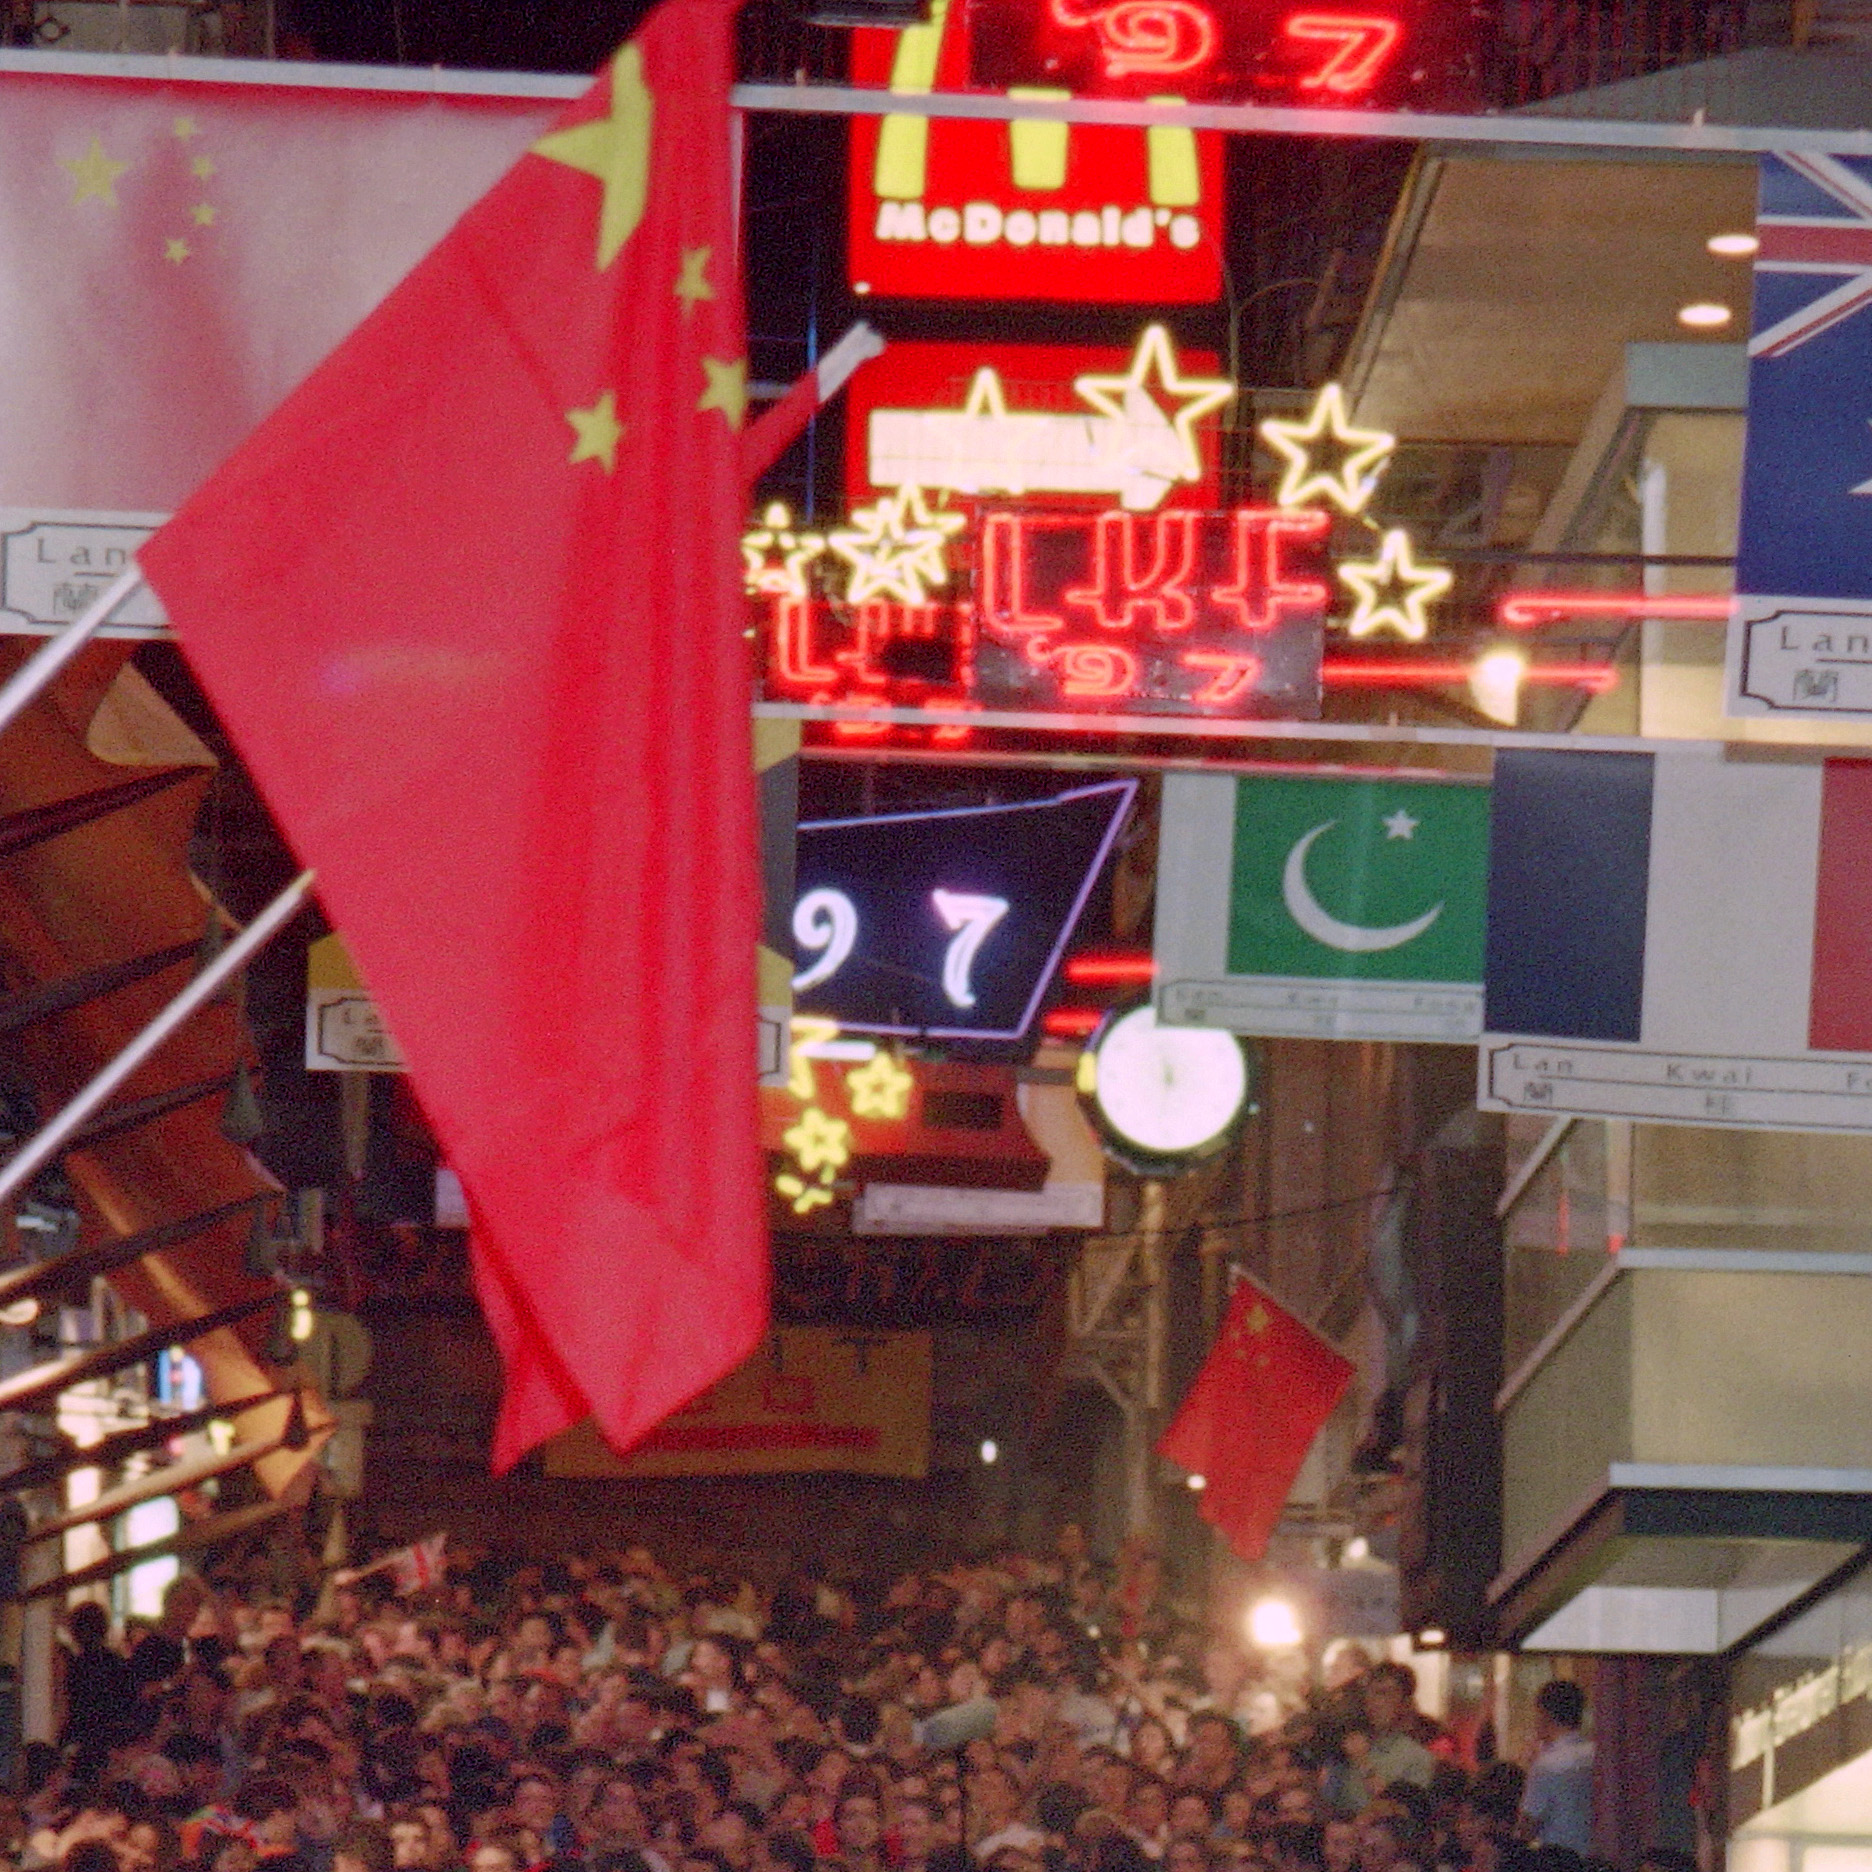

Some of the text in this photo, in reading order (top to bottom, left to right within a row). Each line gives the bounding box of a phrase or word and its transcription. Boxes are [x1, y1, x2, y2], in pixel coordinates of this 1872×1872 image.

[875, 202, 1200, 249] McDonald's
[36, 537, 127, 566] Lan
[982, 510, 1328, 632] LKF
[1780, 625, 1870, 654] Lan
[1512, 1051, 1574, 1074] Lan
[1666, 1062, 1752, 1085] Kwai
